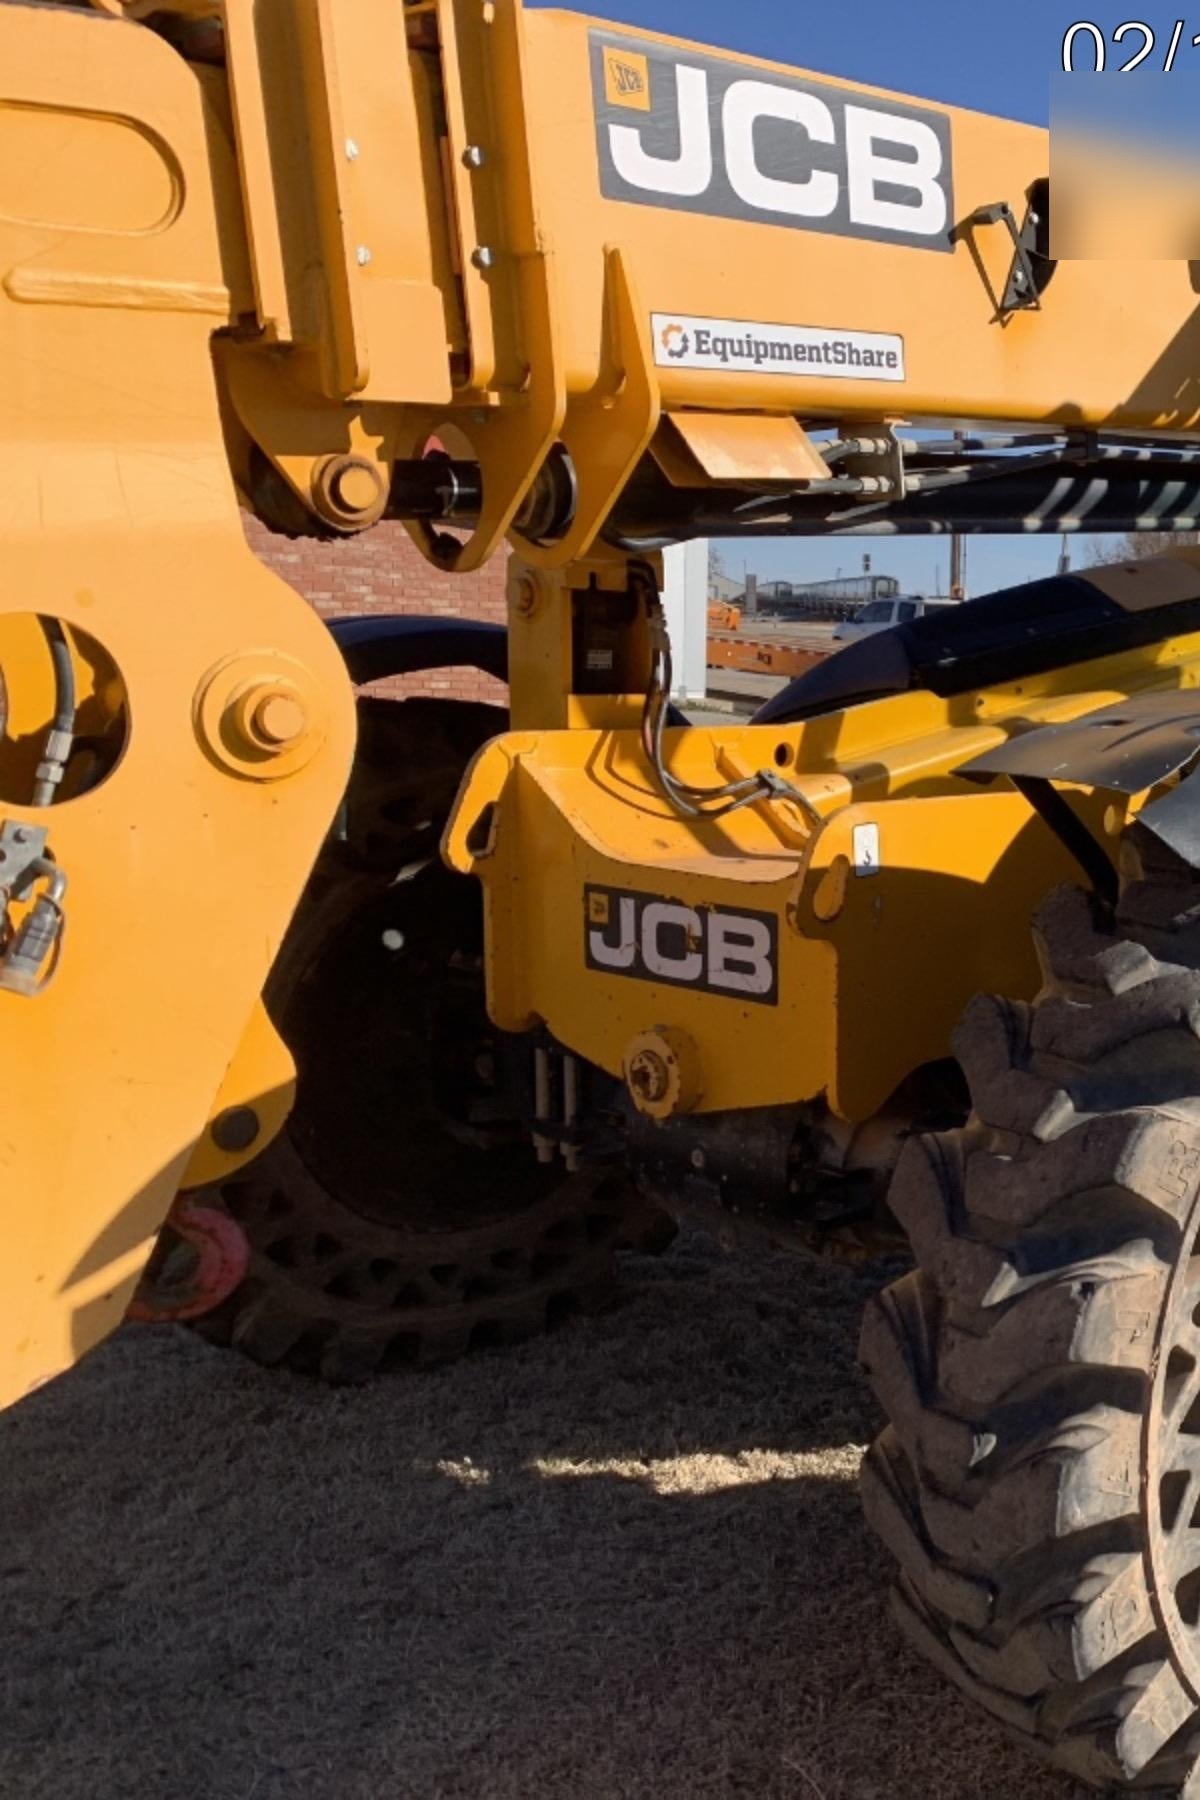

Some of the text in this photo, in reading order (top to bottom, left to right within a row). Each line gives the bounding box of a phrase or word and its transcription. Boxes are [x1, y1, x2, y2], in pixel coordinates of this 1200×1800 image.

[607, 63, 948, 236] JCB
[693, 329, 899, 369] EquipmentShare
[588, 896, 774, 995] JCB
